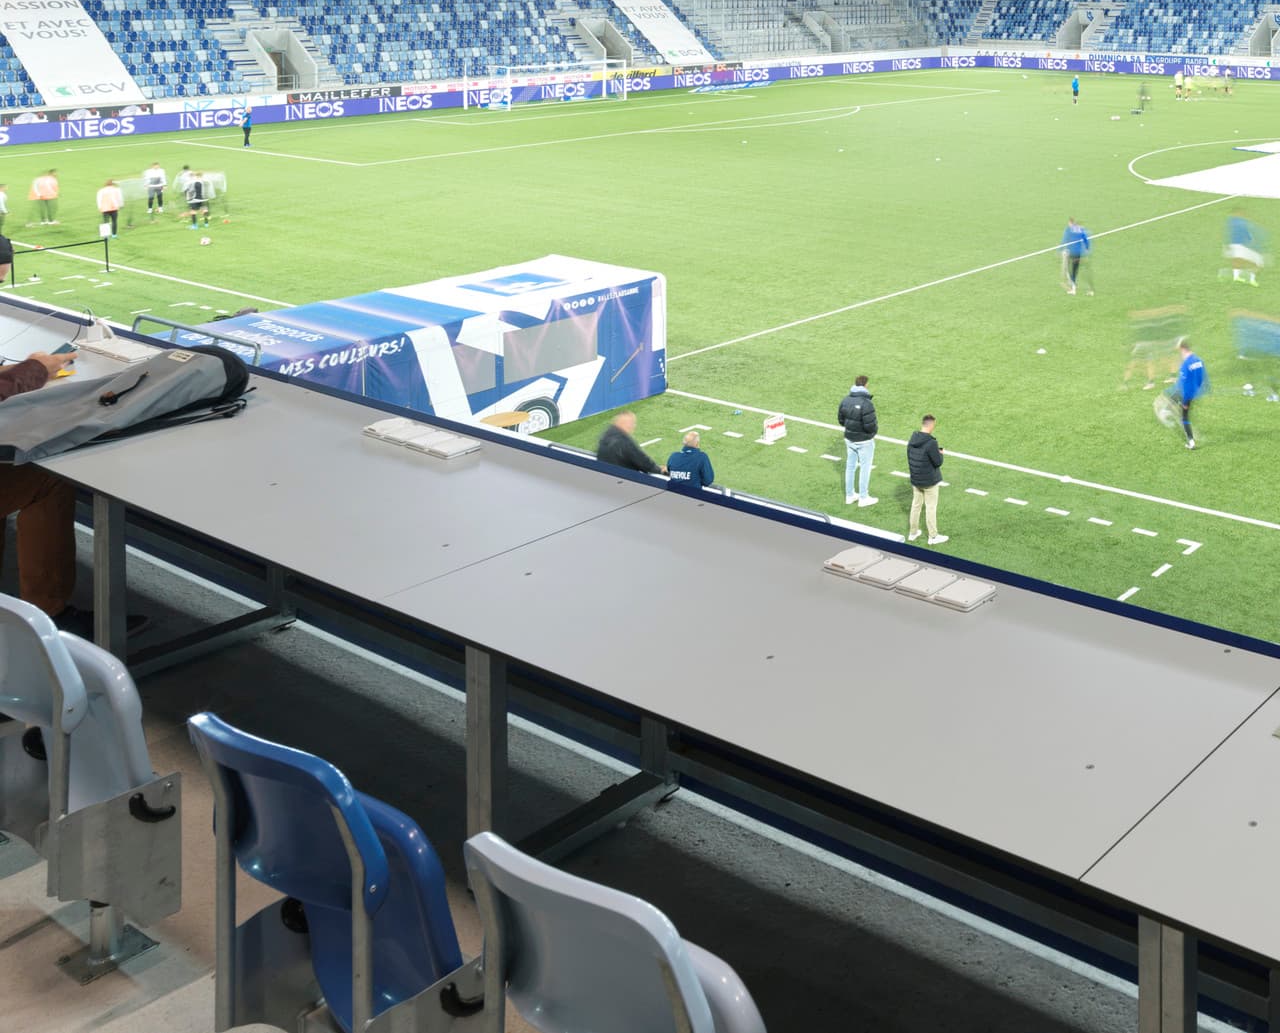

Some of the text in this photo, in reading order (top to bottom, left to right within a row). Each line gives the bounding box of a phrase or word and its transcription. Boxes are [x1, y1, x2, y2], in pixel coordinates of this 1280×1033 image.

[0, 0, 80, 10] ASSION
[3, 19, 92, 30] ET AVEC
[20, 29, 88, 39] VOUS!
[892, 59, 922, 71] INEOS
[941, 56, 976, 67] INEOS
[994, 56, 1022, 67] INEOS
[1039, 59, 1067, 70] INEOS
[1085, 60, 1115, 72] INEOS
[791, 65, 824, 78] INEOS
[843, 62, 875, 74] INEOS
[1133, 62, 1165, 74] INEOS
[1237, 66, 1271, 79] INEOS
[674, 73, 711, 88] INEOS
[734, 69, 769, 81] INEOS
[79, 82, 126, 94] BCV
[541, 83, 585, 98] INEOS
[611, 78, 651, 93] INEOS
[300, 88, 391, 102] MAILLEFER
[379, 95, 432, 112] INEOS
[285, 101, 344, 120] INEOS
[59, 117, 135, 139] INEOS
